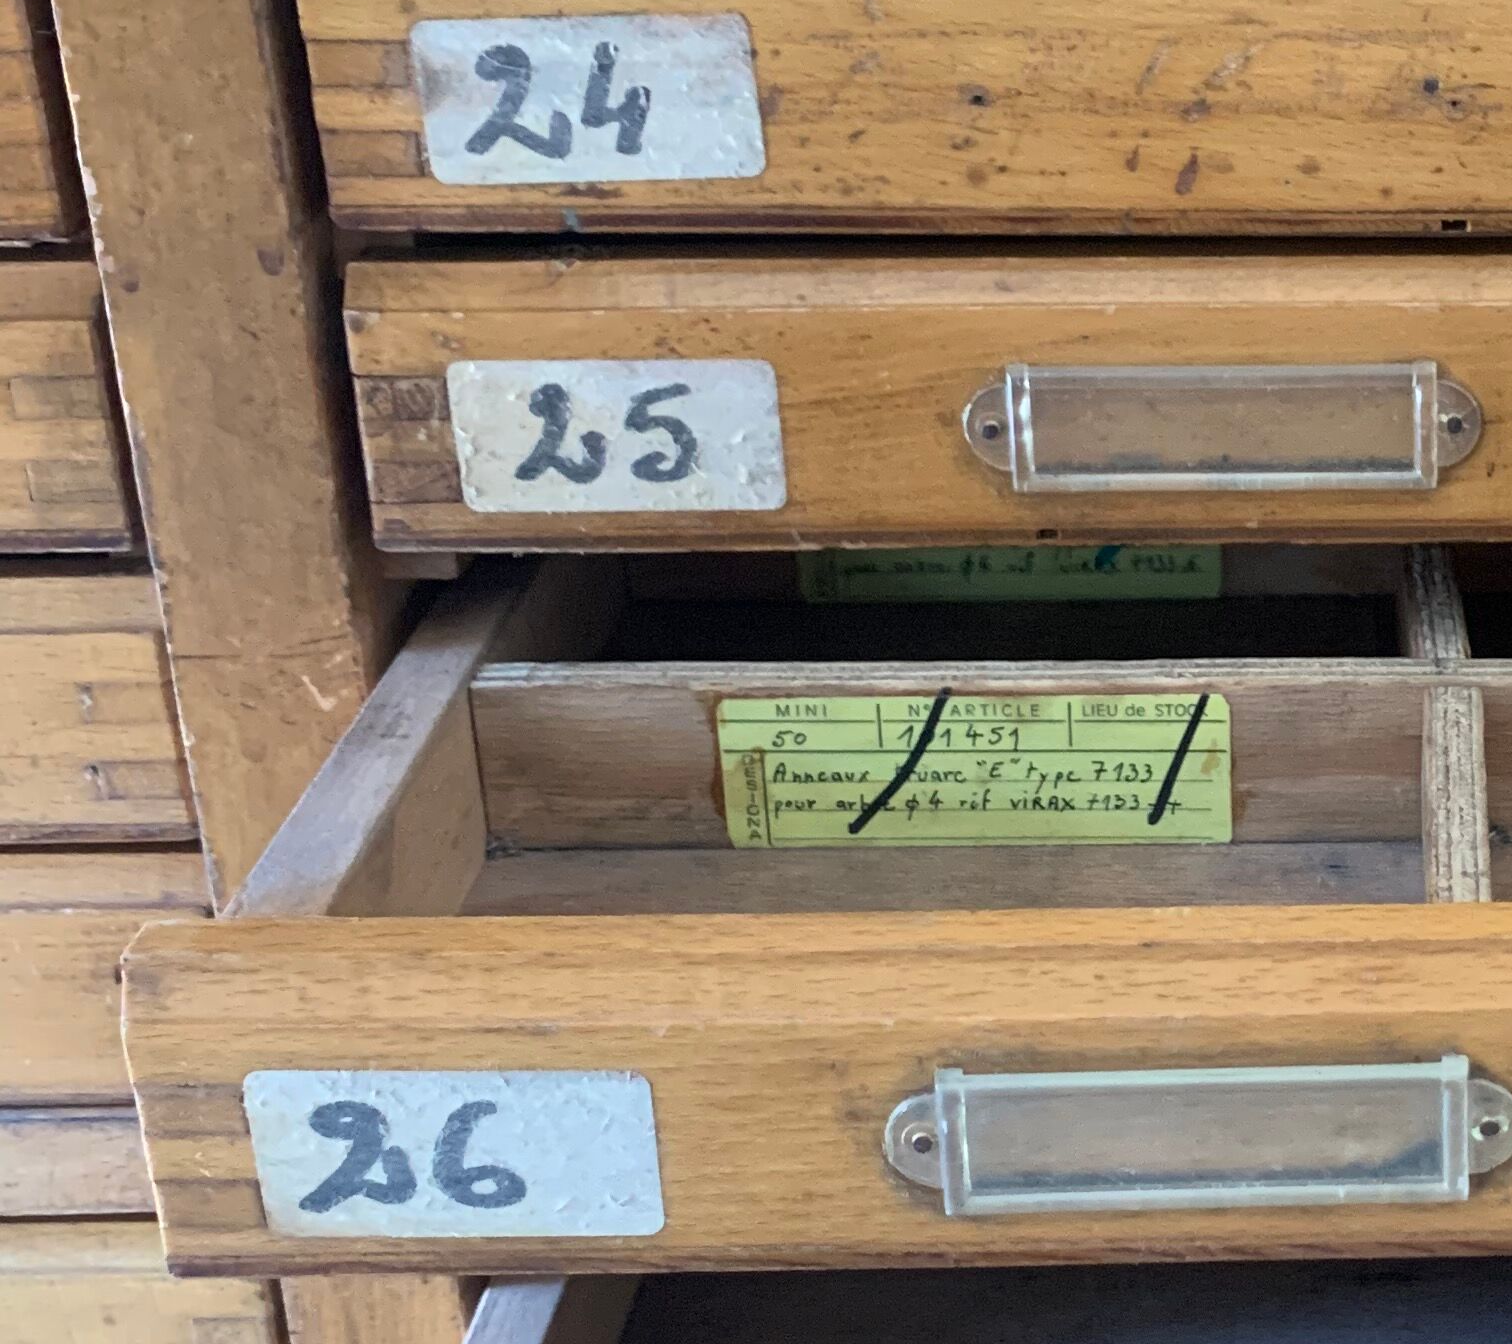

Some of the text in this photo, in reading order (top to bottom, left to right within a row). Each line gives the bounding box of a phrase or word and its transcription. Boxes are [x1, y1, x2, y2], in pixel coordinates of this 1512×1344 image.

[465, 41, 652, 159] 24
[514, 383, 698, 484] 25
[775, 703, 828, 718] MINI
[950, 703, 1041, 718] ARTICLE
[1082, 703, 1209, 718] LIEU de STOC
[772, 729, 807, 748] 50
[773, 762, 871, 783] Anneaux
[1091, 760, 1153, 784] 7133
[774, 799, 817, 820] pour
[299, 1099, 528, 1213] 26
